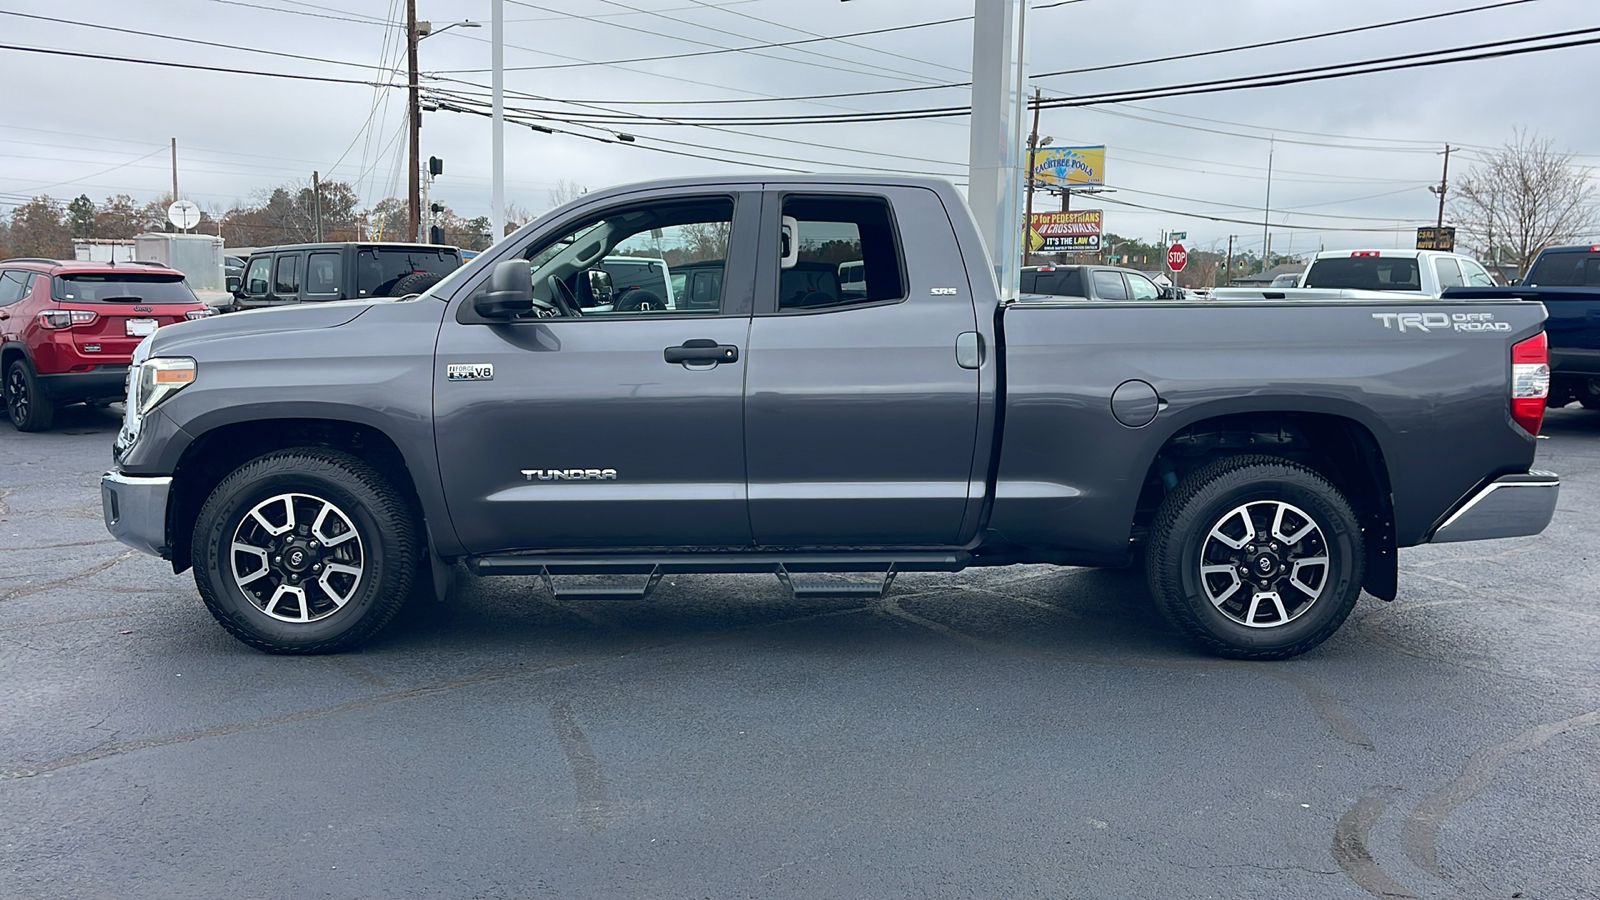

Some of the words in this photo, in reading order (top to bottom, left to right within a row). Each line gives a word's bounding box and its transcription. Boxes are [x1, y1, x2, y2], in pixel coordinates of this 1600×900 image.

[1034, 159, 1070, 175] EACHTREE
[1071, 160, 1093, 177] POOLS
[1039, 214, 1050, 224] for
[1051, 212, 1100, 224] PEDESTRIANS
[1037, 224, 1047, 234] IN
[1047, 222, 1100, 234] CROSSWALKS
[1046, 237, 1060, 245] IT'S
[1060, 237, 1072, 245] THE
[1073, 236, 1088, 245] LAW
[1168, 251, 1186, 263] STOP
[930, 287, 957, 296] SR5
[1372, 312, 1451, 333] TRD
[1452, 312, 1494, 322] OFF
[1454, 322, 1512, 332] ROAD
[475, 367, 491, 377] V8
[520, 469, 617, 481] TUNDRA
